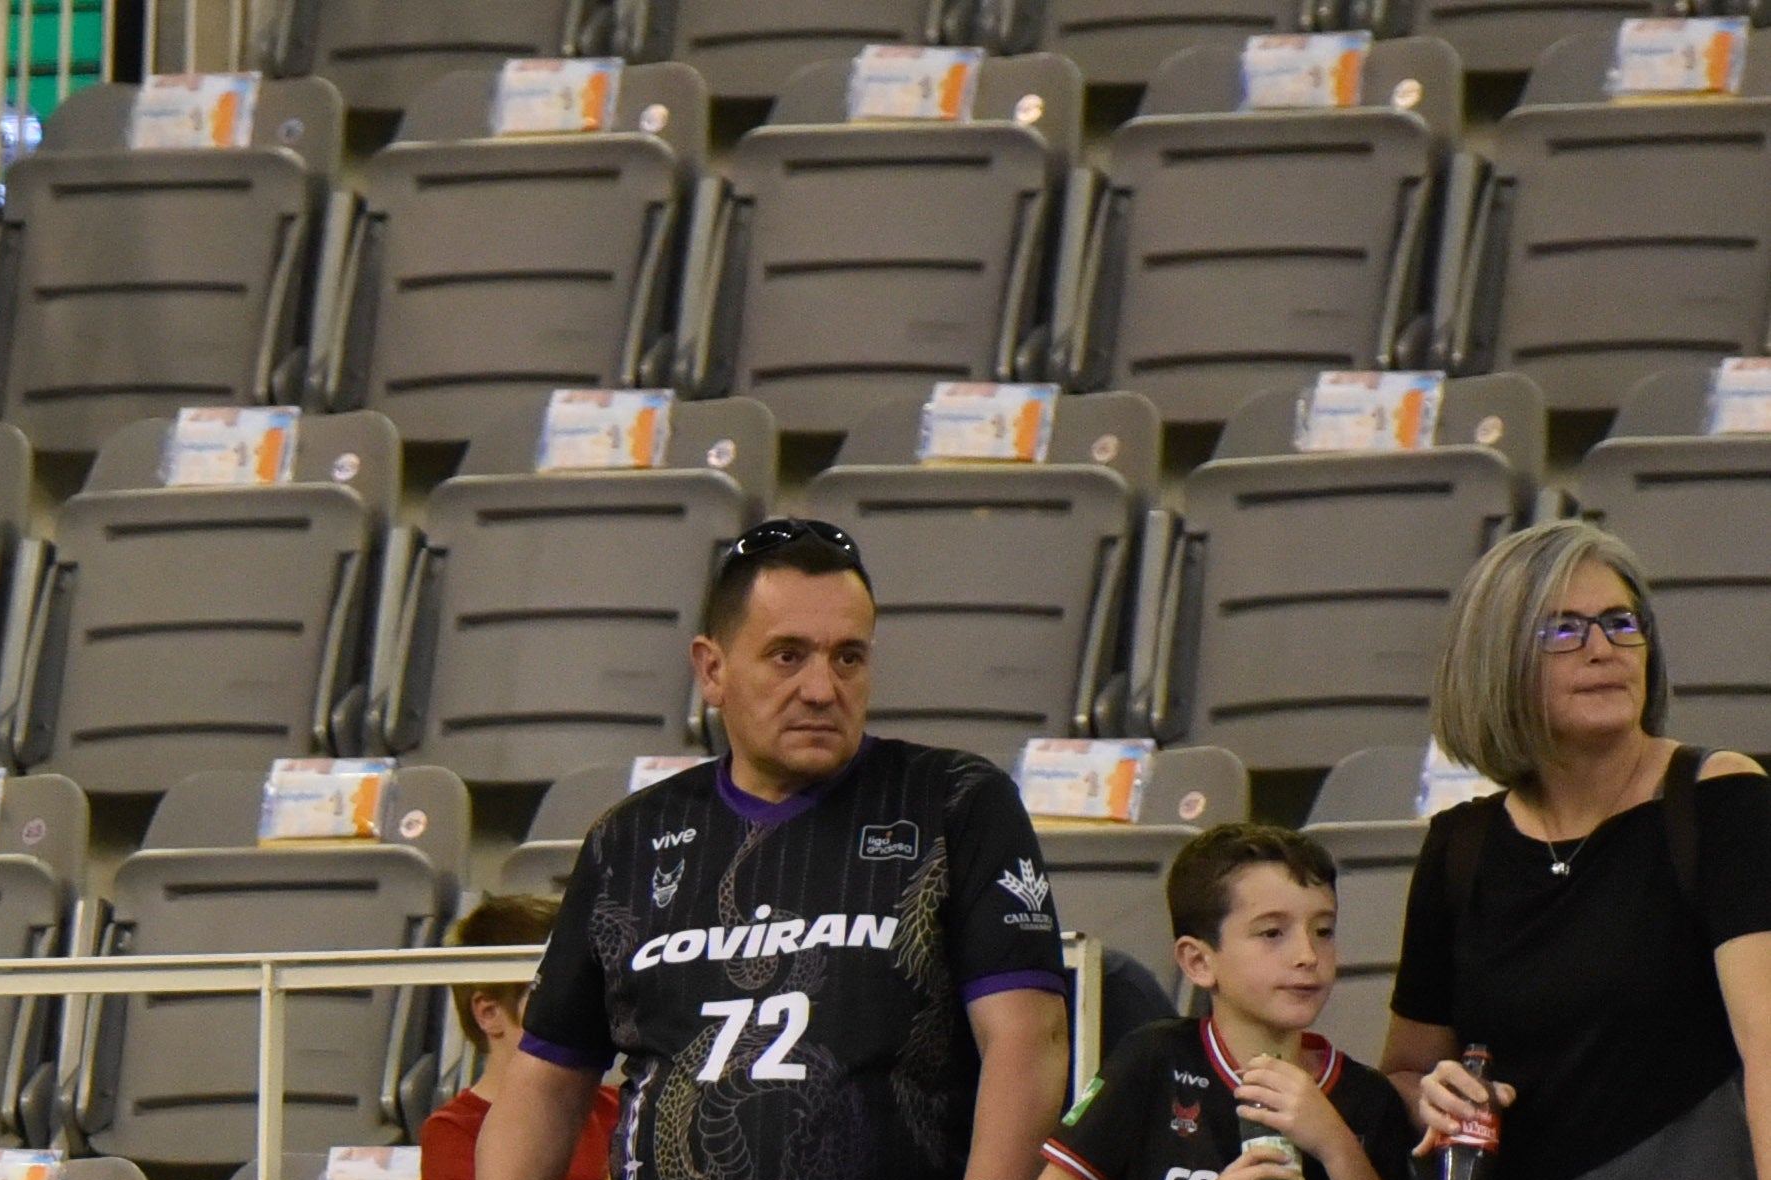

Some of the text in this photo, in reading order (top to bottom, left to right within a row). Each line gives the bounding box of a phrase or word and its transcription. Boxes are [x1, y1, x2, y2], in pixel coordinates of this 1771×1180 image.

[651, 827, 697, 851] vive
[696, 991, 810, 1082] 72
[1173, 1069, 1210, 1089] vive
